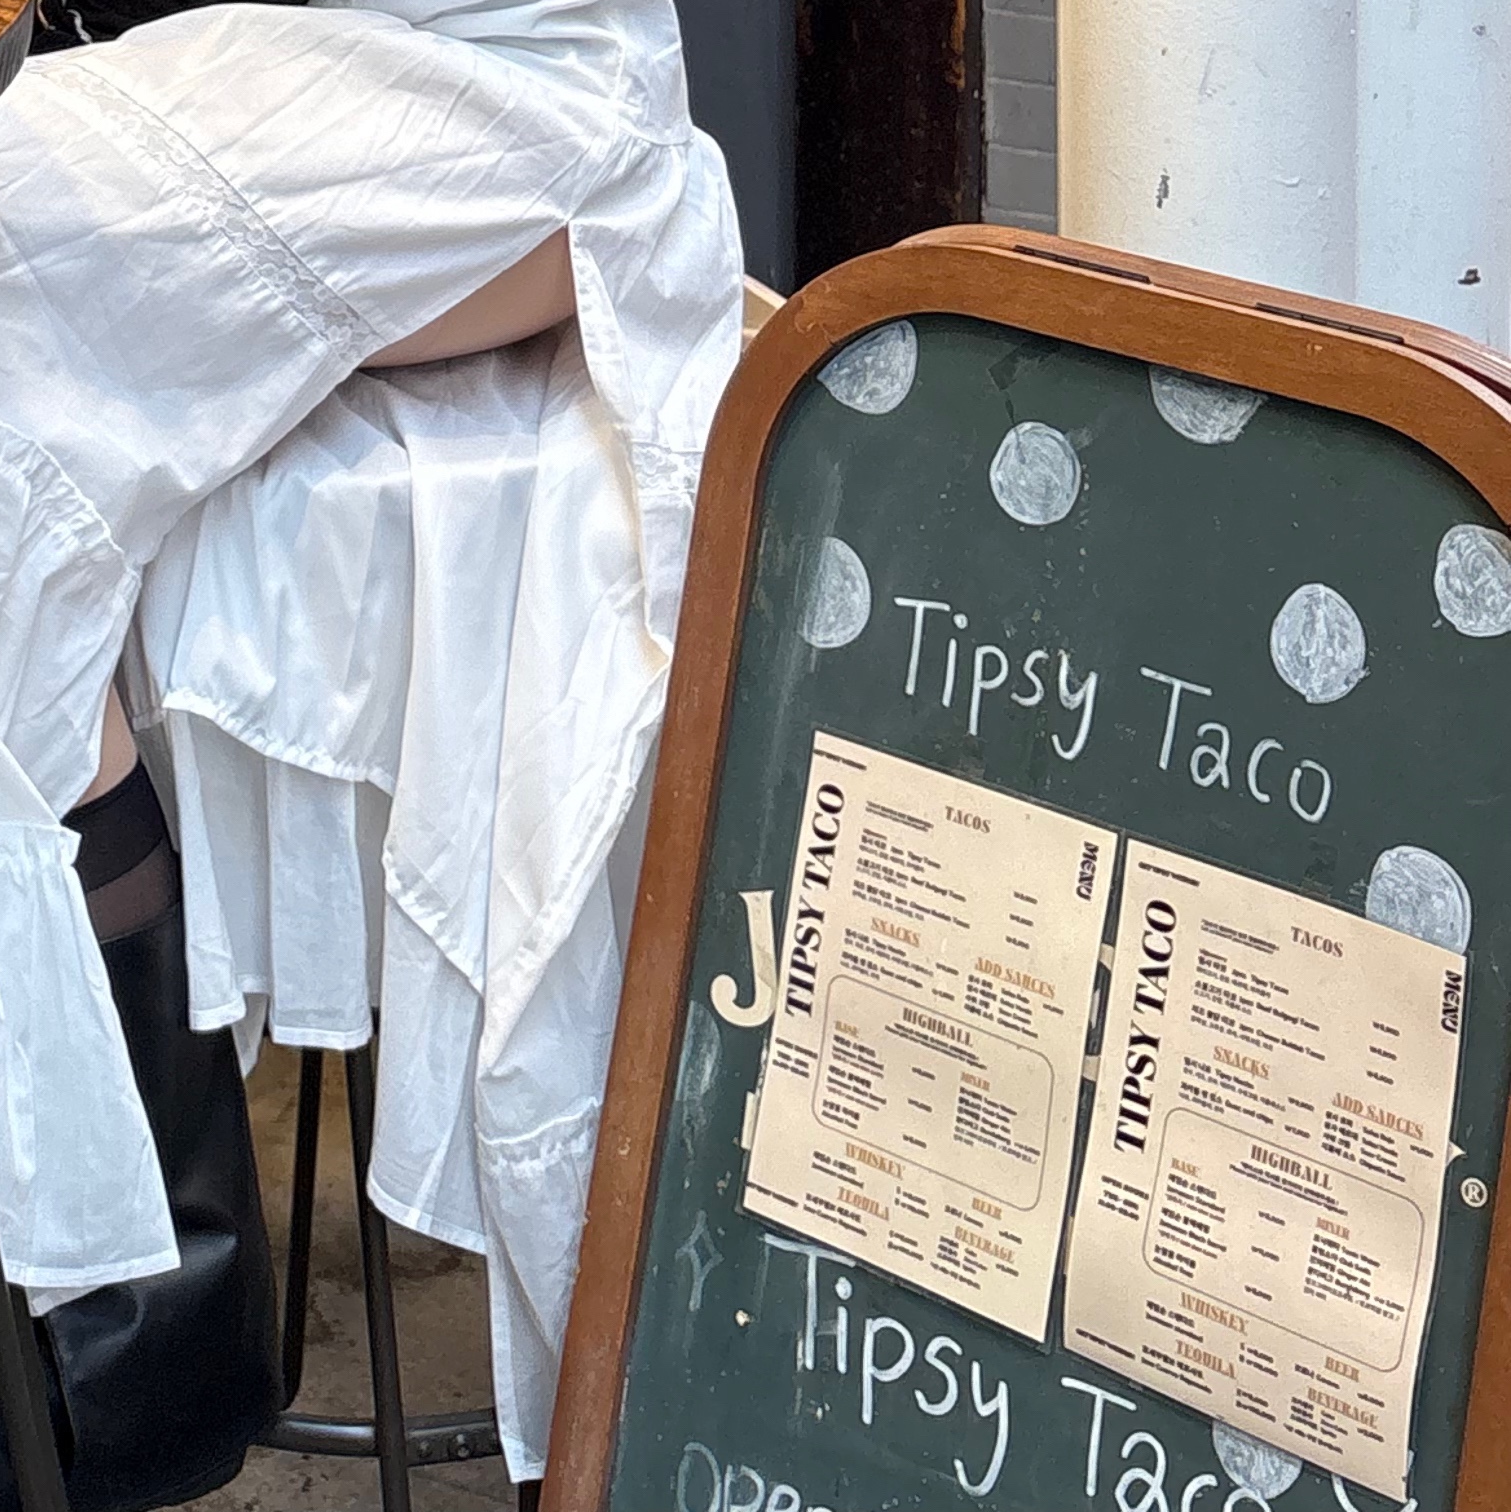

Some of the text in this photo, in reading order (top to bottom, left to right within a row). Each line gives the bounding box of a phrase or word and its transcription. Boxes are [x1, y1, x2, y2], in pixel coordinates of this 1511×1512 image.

[893, 596, 1334, 823] Tipsy Taco
[802, 783, 845, 891] TACO
[943, 804, 991, 835] TACOS
[1076, 841, 1100, 901] MENU
[870, 915, 921, 949] SNACKS
[1289, 925, 1344, 959] TACOS
[785, 895, 827, 1019] TIPSY
[974, 955, 1056, 1000] ADD SAUCES
[1133, 898, 1177, 1016] TACO
[1441, 969, 1463, 1034] MENU
[901, 1005, 974, 1048] HIGHBALL
[1212, 1043, 1270, 1080] SNACKS
[1114, 1020, 1161, 1154] TIPSY
[1331, 1089, 1424, 1141] ADD SAUCES
[844, 1140, 905, 1180] WHISKEY
[1249, 1142, 1334, 1192] HIGHBALL
[837, 1185, 891, 1222] TEQUILA
[971, 1196, 1002, 1221] BEER
[1178, 1290, 1249, 1336] WHISKEY
[763, 1233, 1009, 1498] Tipsy
[1174, 1338, 1237, 1380] TEQUILA
[1325, 1355, 1360, 1383] BEER
[1306, 1385, 1379, 1430] BEVERAGE
